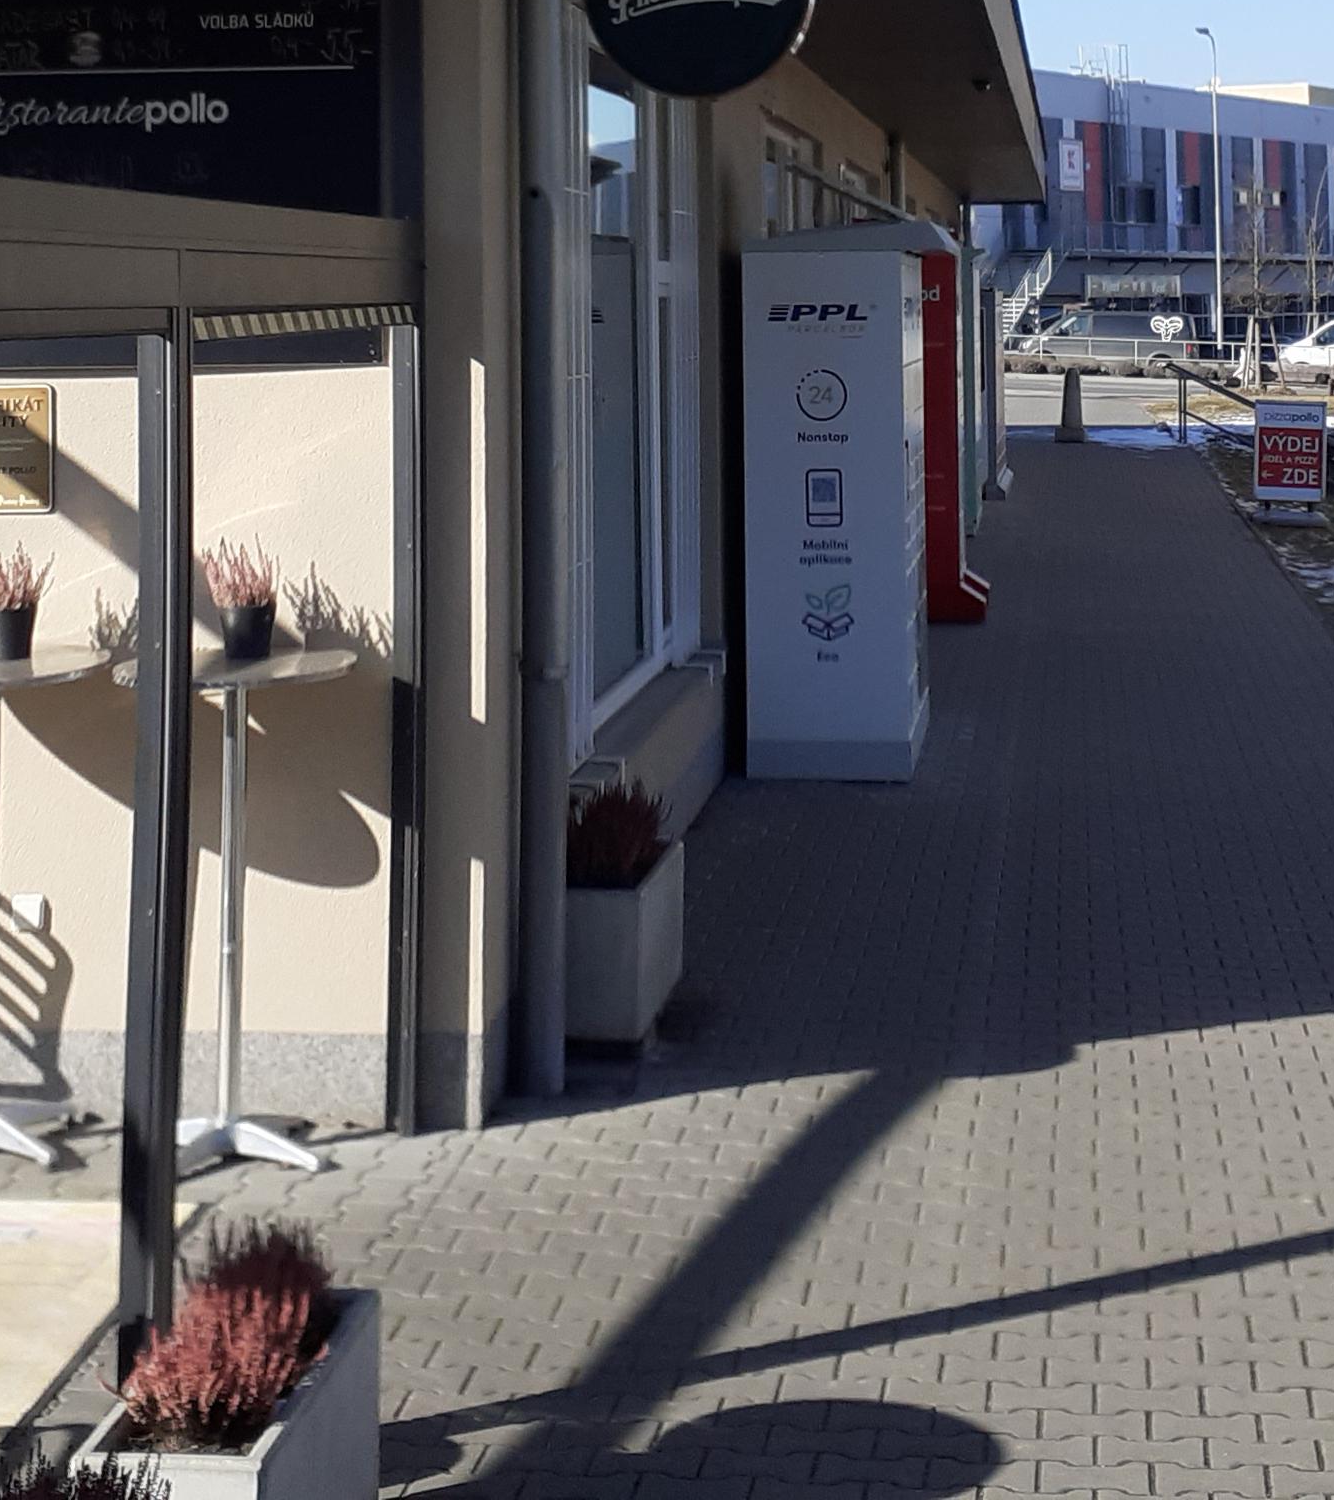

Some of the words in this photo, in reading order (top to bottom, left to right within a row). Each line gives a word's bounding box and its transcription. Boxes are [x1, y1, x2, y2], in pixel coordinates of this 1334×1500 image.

[199, 14, 250, 30] VOLBA
[789, 304, 868, 322] PPL
[808, 386, 836, 405] 24
[797, 431, 849, 446] Nonstop
[1262, 432, 1320, 452] VÝDEJ
[1282, 468, 1319, 485] ZDE
